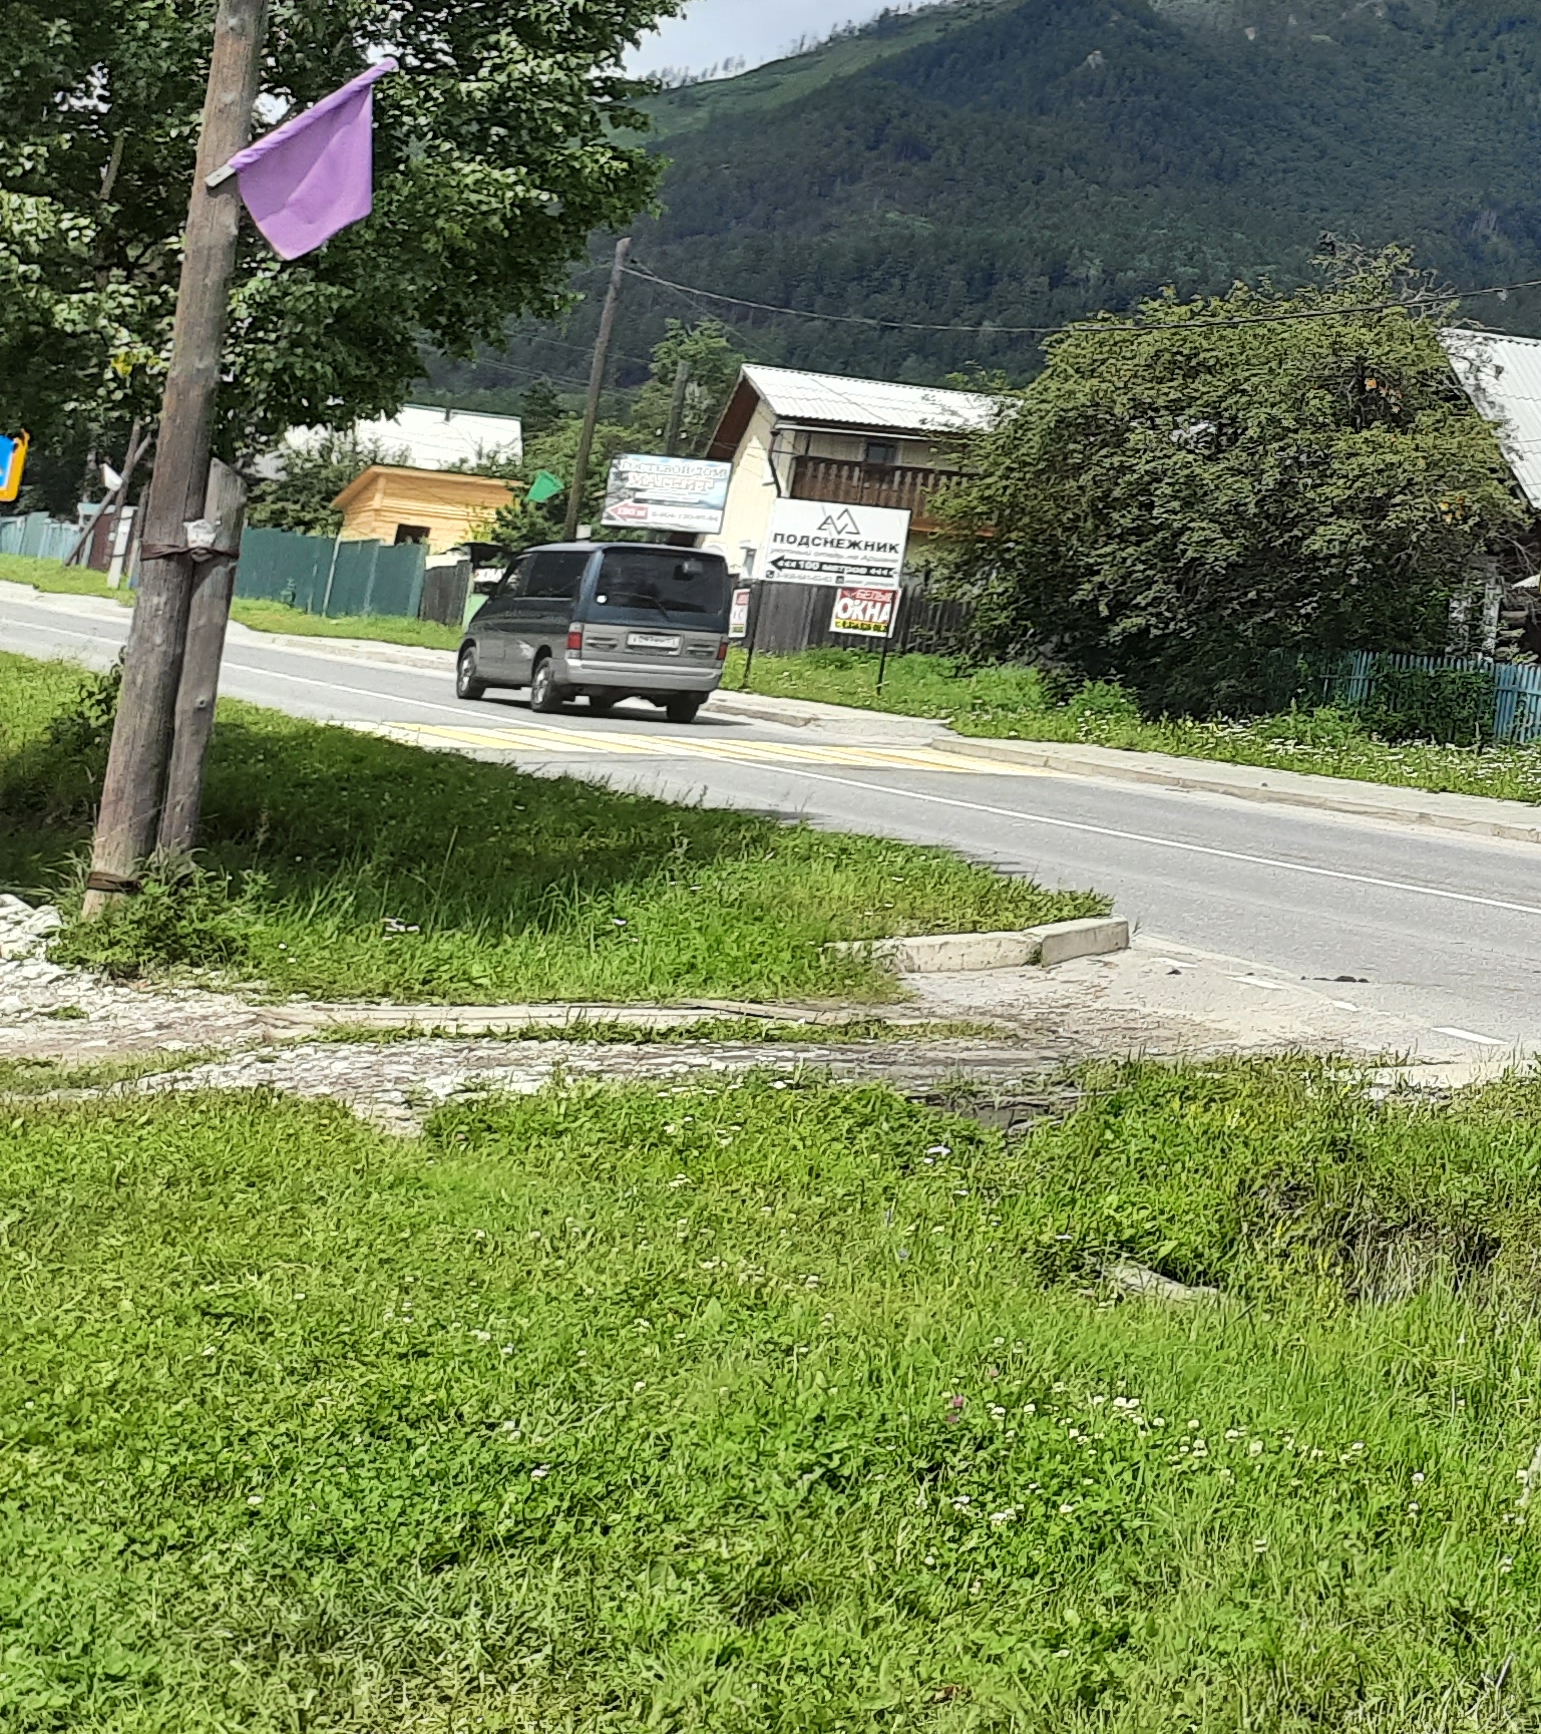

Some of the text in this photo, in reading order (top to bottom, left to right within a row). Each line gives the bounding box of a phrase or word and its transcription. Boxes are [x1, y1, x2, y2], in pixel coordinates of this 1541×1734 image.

[773, 533, 900, 554] ПОДСНЕЖНИК
[856, 589, 893, 603] БЕЛЫ
[837, 597, 892, 624] ОКНА
